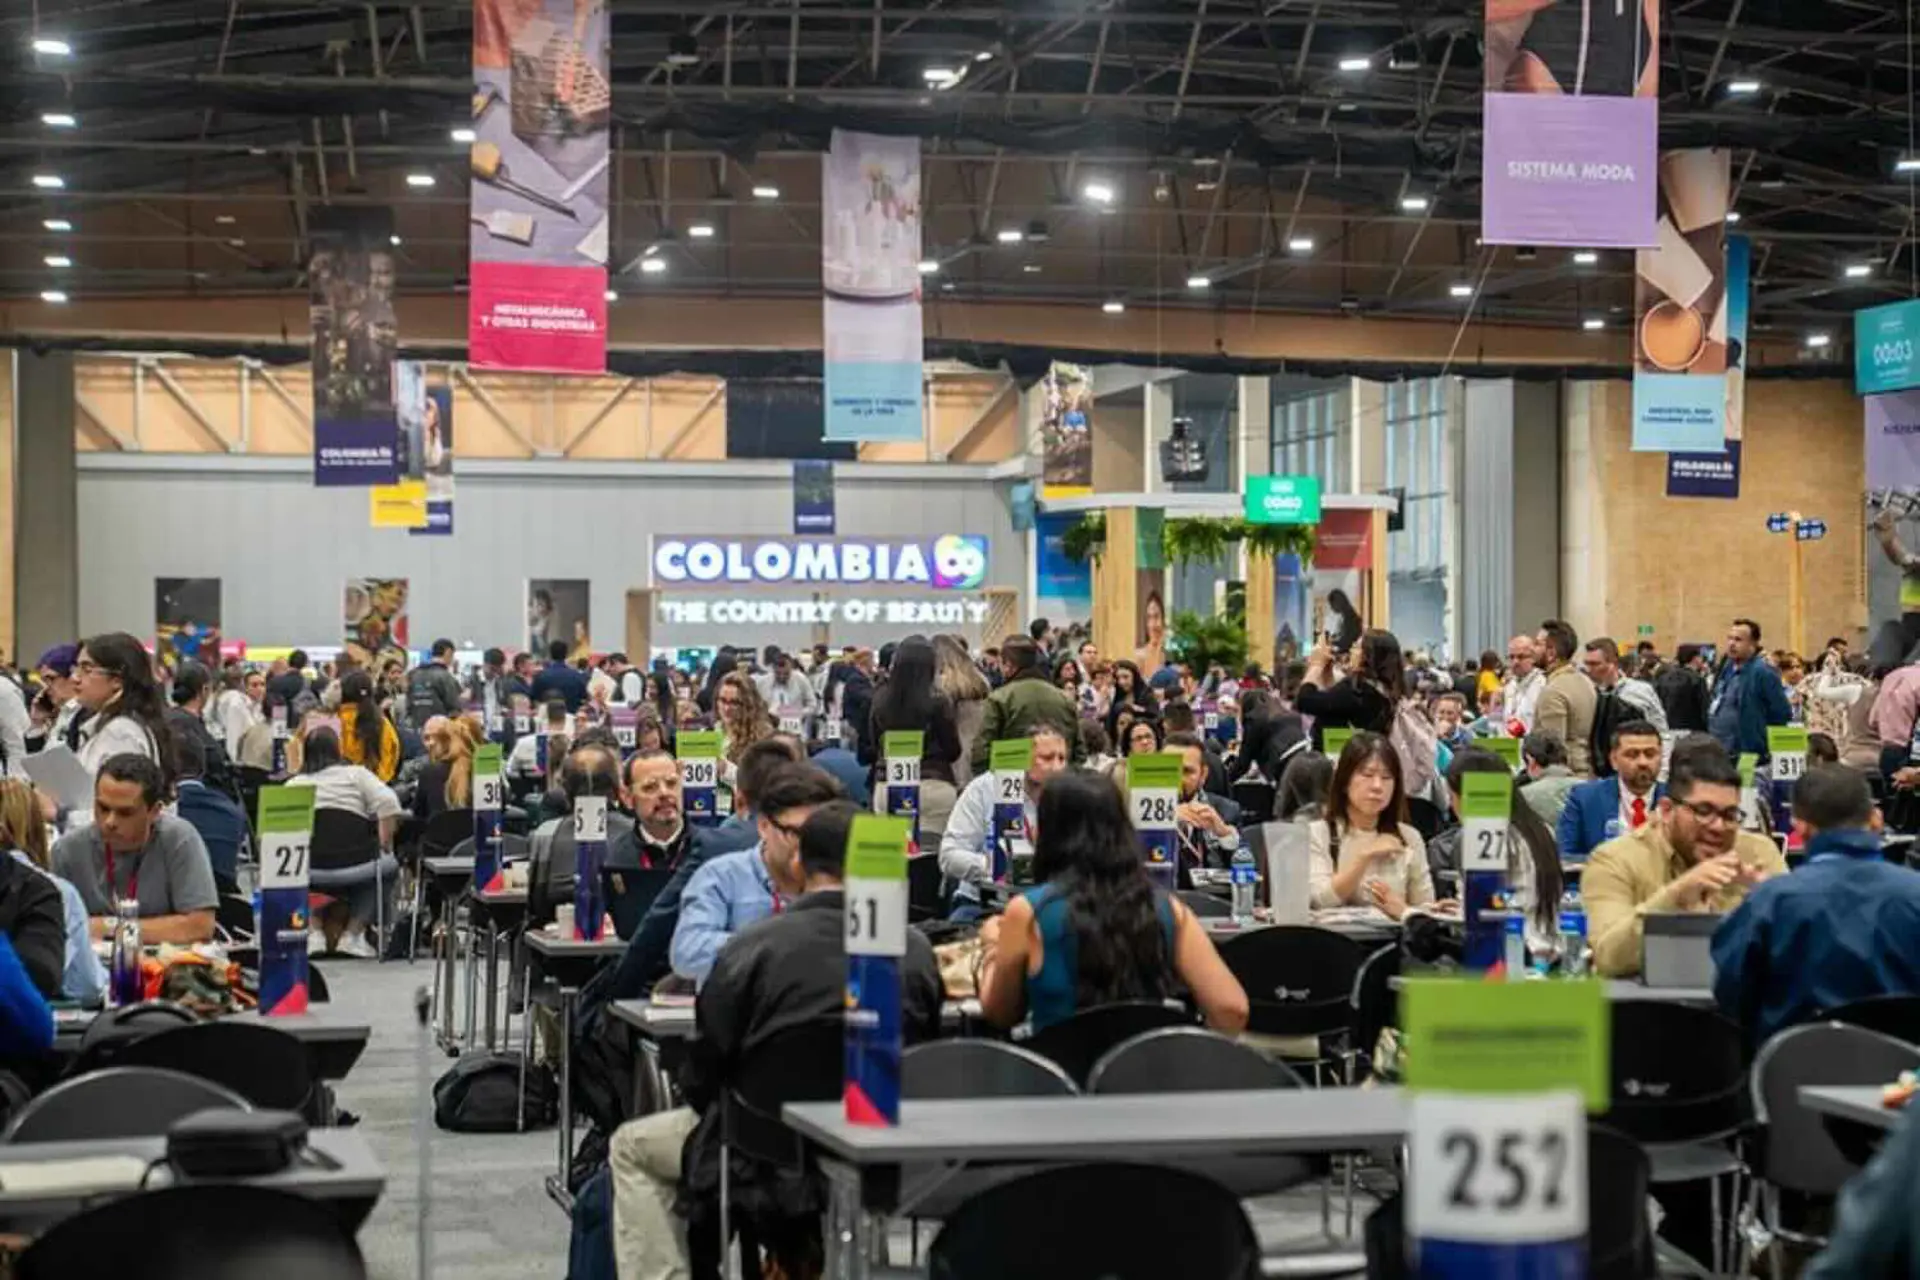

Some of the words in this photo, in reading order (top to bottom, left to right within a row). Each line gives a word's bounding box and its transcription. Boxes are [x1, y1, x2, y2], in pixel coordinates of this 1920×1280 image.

[1508, 161, 1576, 178] SISTEMA
[1580, 163, 1636, 182] MODA
[655, 541, 931, 581] COLOMBIA
[660, 601, 708, 623] THE
[711, 601, 838, 623] COUNTRY
[842, 600, 881, 622] OF
[685, 764, 714, 782] 309
